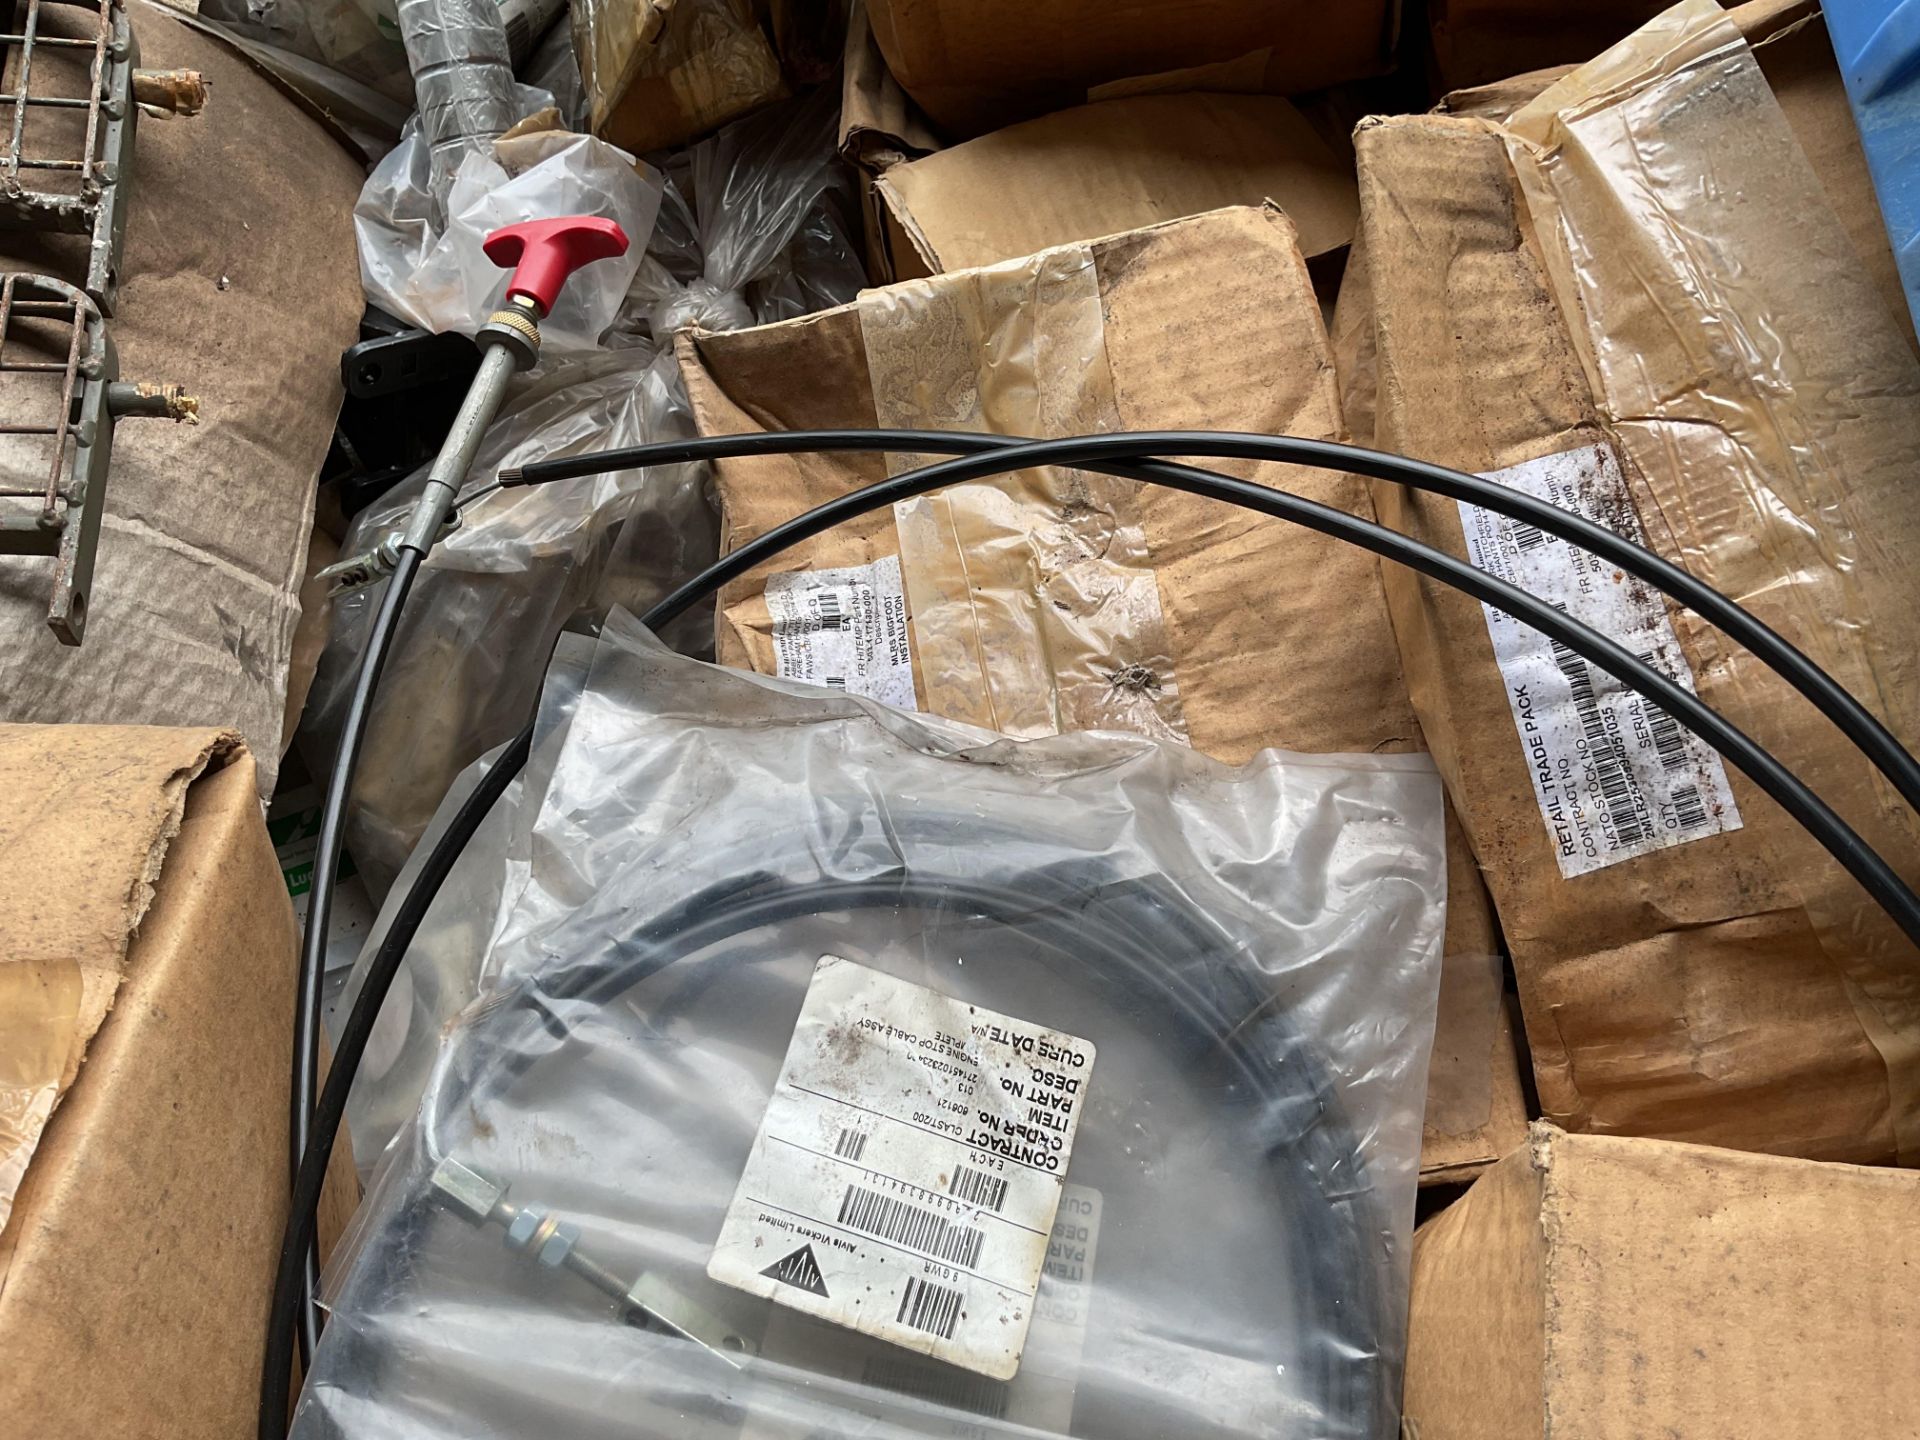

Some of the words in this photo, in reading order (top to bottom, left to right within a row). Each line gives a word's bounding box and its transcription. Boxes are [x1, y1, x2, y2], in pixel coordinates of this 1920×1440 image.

[1471, 505, 1492, 558] TITCHFIELD
[1481, 514, 1493, 538] PO14
[1472, 538, 1485, 570] Limited
[1488, 540, 1502, 572] HANTS
[1579, 576, 1592, 594] FR
[808, 598, 816, 606] Q
[841, 617, 851, 631] EA
[883, 595, 895, 636] BIGFOOT
[895, 595, 909, 663] INSTALLATION
[795, 642, 804, 678] FAREHAM
[889, 638, 899, 665] MLRS
[857, 663, 865, 676] FR
[1514, 683, 1538, 732] PACK
[1626, 699, 1652, 749] SERIAL
[1575, 737, 1590, 760] NO
[1529, 735, 1556, 793] TRADE
[1555, 753, 1572, 779] NO.
[1582, 761, 1606, 809] STOCK
[1546, 795, 1576, 856] RETAIL
[1563, 781, 1597, 858] CONTRACT
[1658, 799, 1678, 829] QTY
[1597, 811, 1619, 851] NATO
[856, 1016, 885, 1032] ASSY
[885, 1025, 917, 1043] CABLE
[969, 1023, 988, 1037] N/A
[917, 1036, 945, 1053] STOP
[945, 1046, 979, 1066] ENGINE
[1036, 1040, 1085, 1068] CURE
[956, 1081, 974, 1094] 013
[996, 1076, 1025, 1097] No.
[1026, 1065, 1078, 1093] DESC.
[936, 1097, 969, 1115] 606121
[1026, 1086, 1073, 1113] PART
[911, 1110, 963, 1135] CLAST/200
[973, 1109, 1001, 1130] No.
[1026, 1106, 1069, 1132] ITEM
[965, 1127, 1060, 1170] CONTRACT
[1002, 1119, 1064, 1152] ORDER
[757, 1212, 794, 1232] Limited
[795, 1225, 831, 1245] Vickers
[832, 1237, 857, 1253] Alvis
